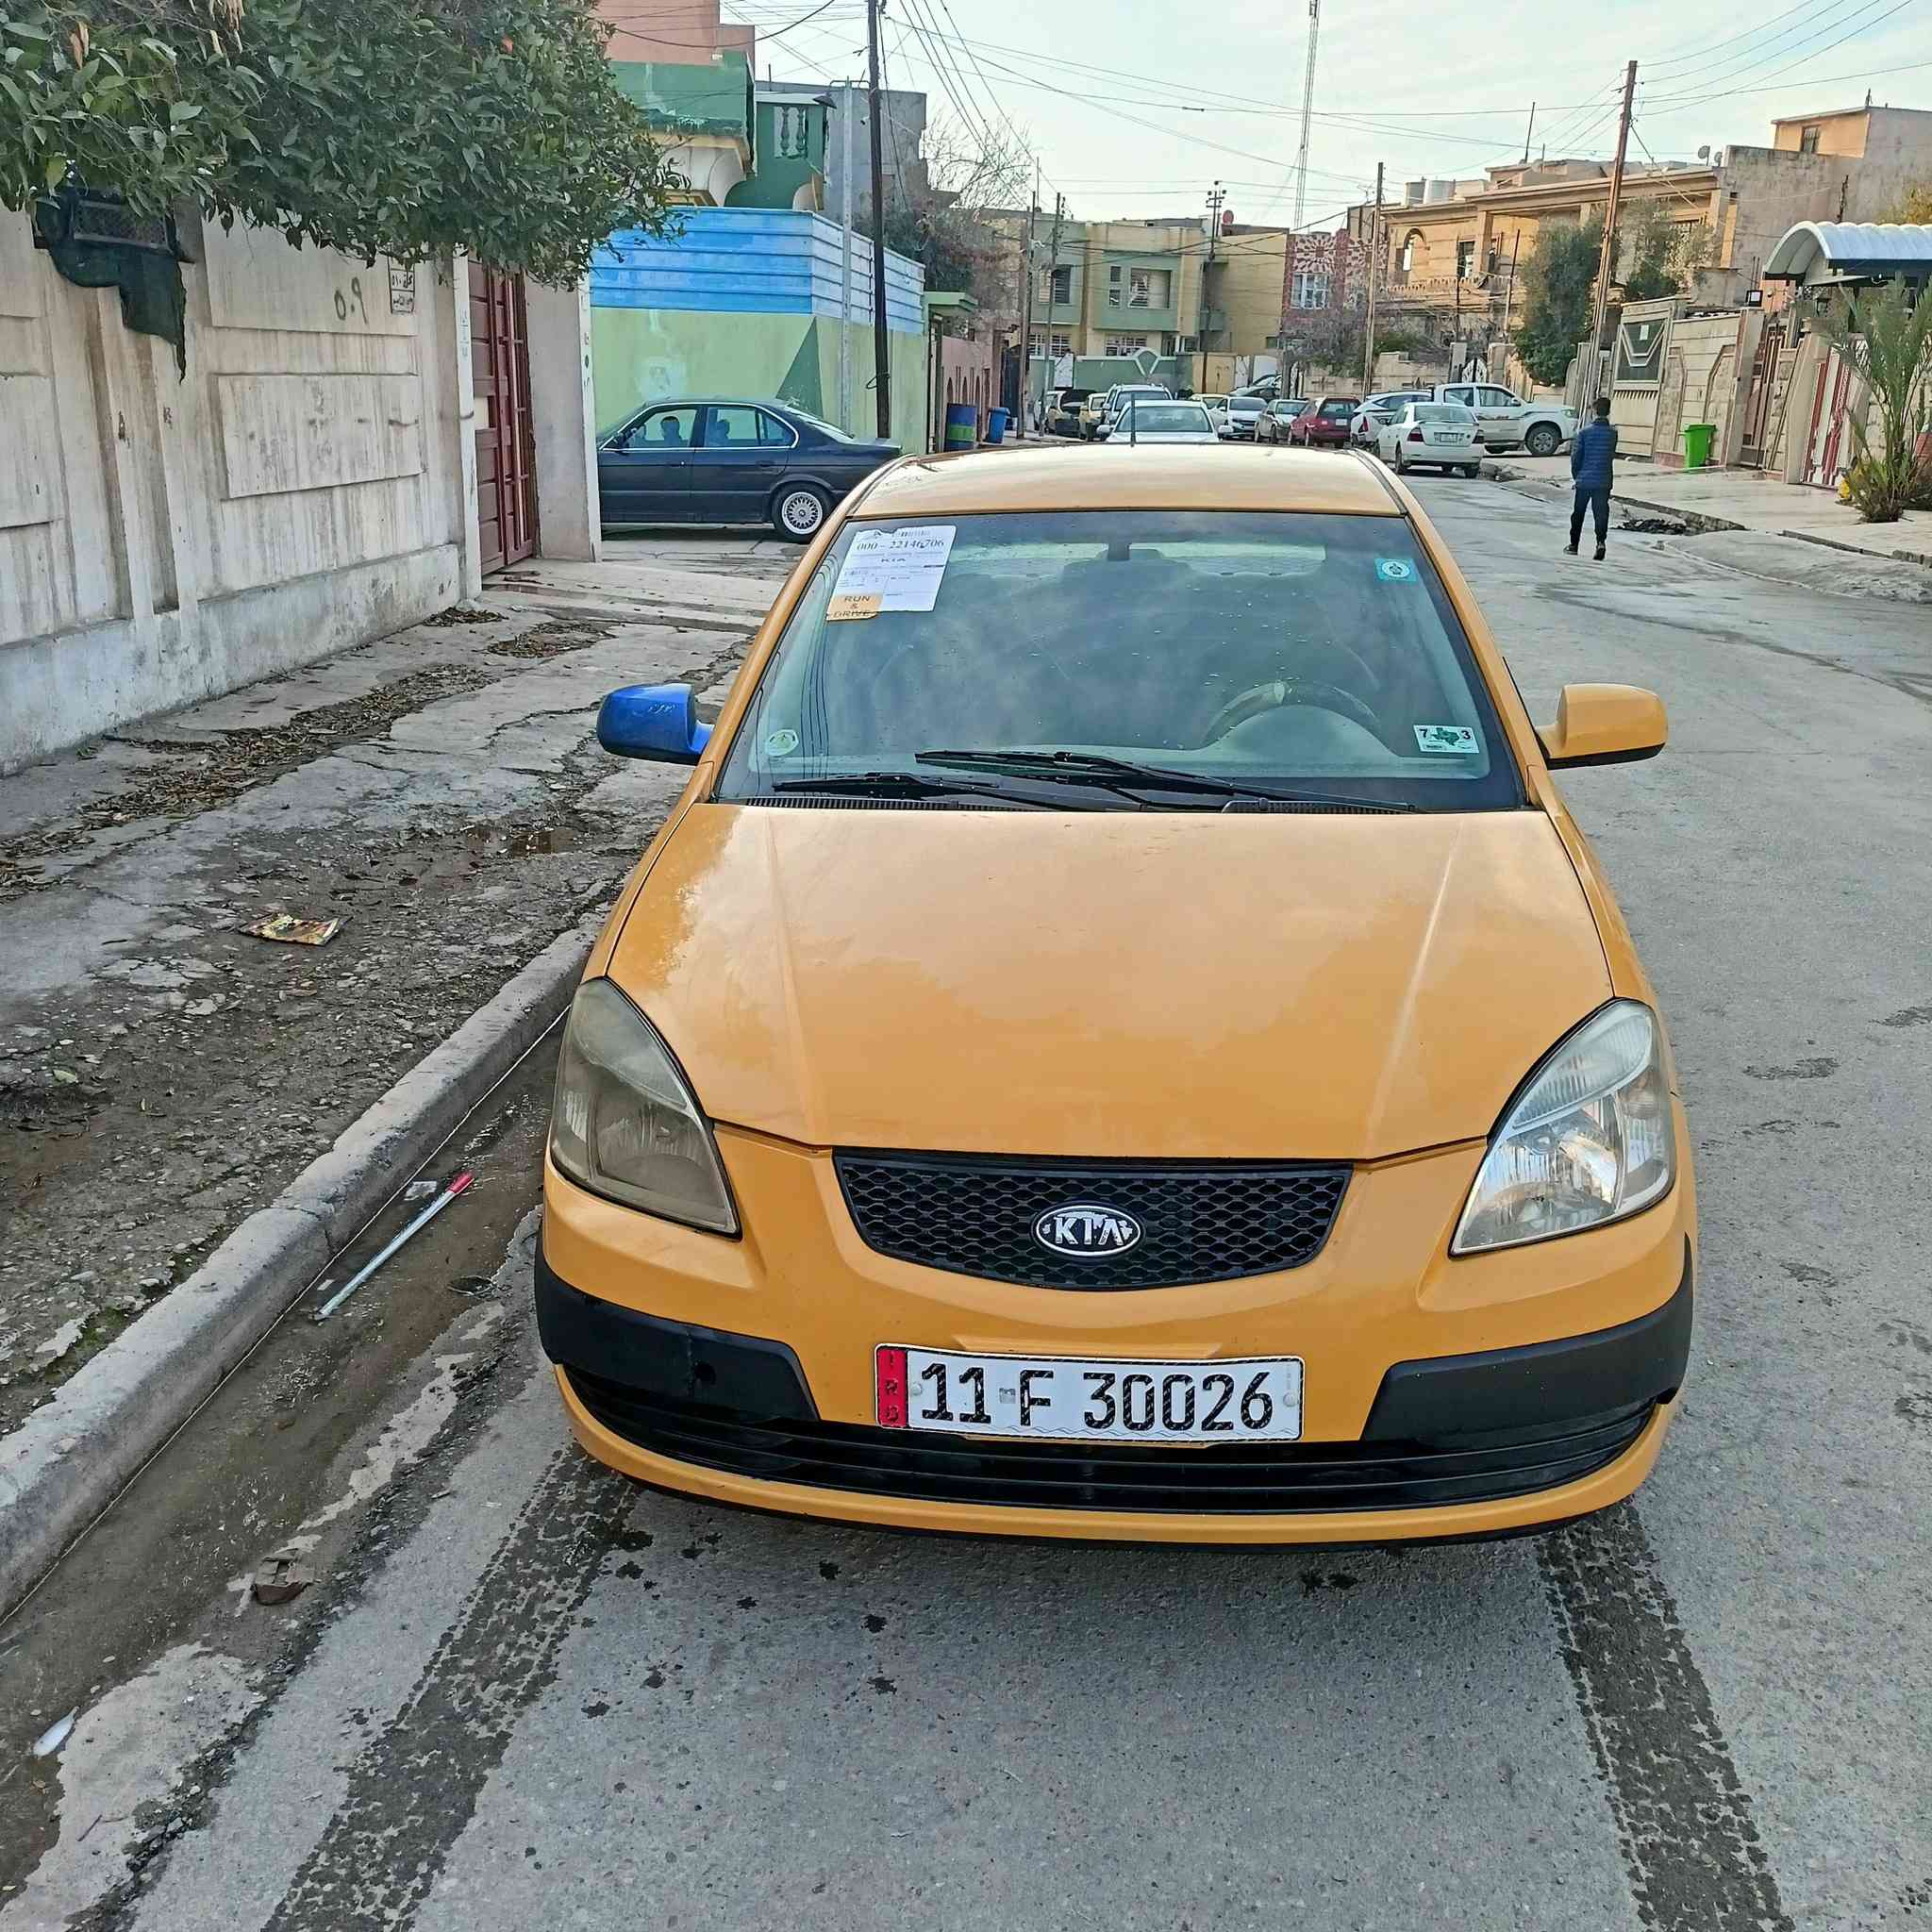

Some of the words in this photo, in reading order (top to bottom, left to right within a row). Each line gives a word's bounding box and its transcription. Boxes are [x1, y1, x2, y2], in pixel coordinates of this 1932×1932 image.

[1054, 1216, 1124, 1246] KIA
[921, 1362, 991, 1424] 11
[1019, 1369, 1055, 1427] F
[1083, 1371, 1274, 1432] 30026
